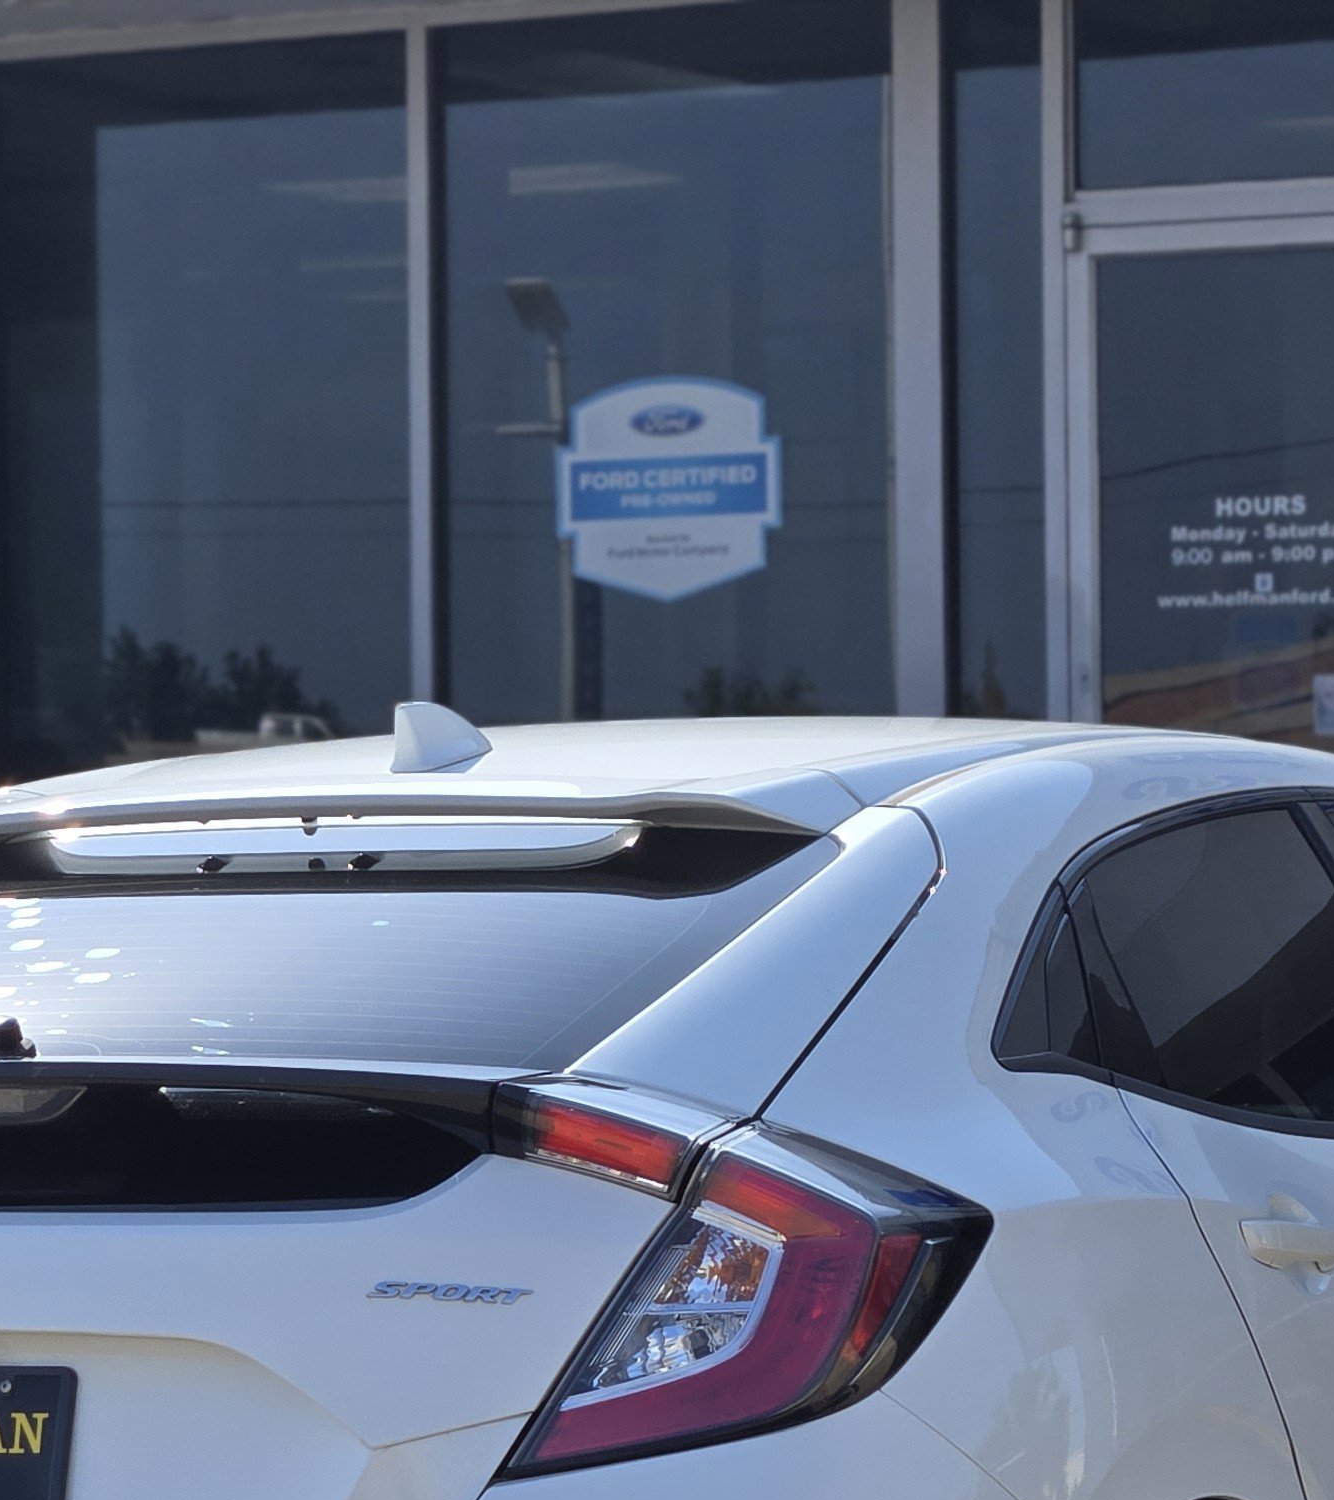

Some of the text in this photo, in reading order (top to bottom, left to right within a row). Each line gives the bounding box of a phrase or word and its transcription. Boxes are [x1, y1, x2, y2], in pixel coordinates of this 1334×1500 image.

[579, 464, 757, 490] FORD CERTIFIED
[1215, 495, 1306, 517] HOURS
[1170, 525, 1247, 545] Monday
[1171, 547, 1214, 566] 9:00
[1221, 551, 1254, 564] am
[1271, 545, 1316, 562] 9:00
[366, 1281, 535, 1305] SPORT
